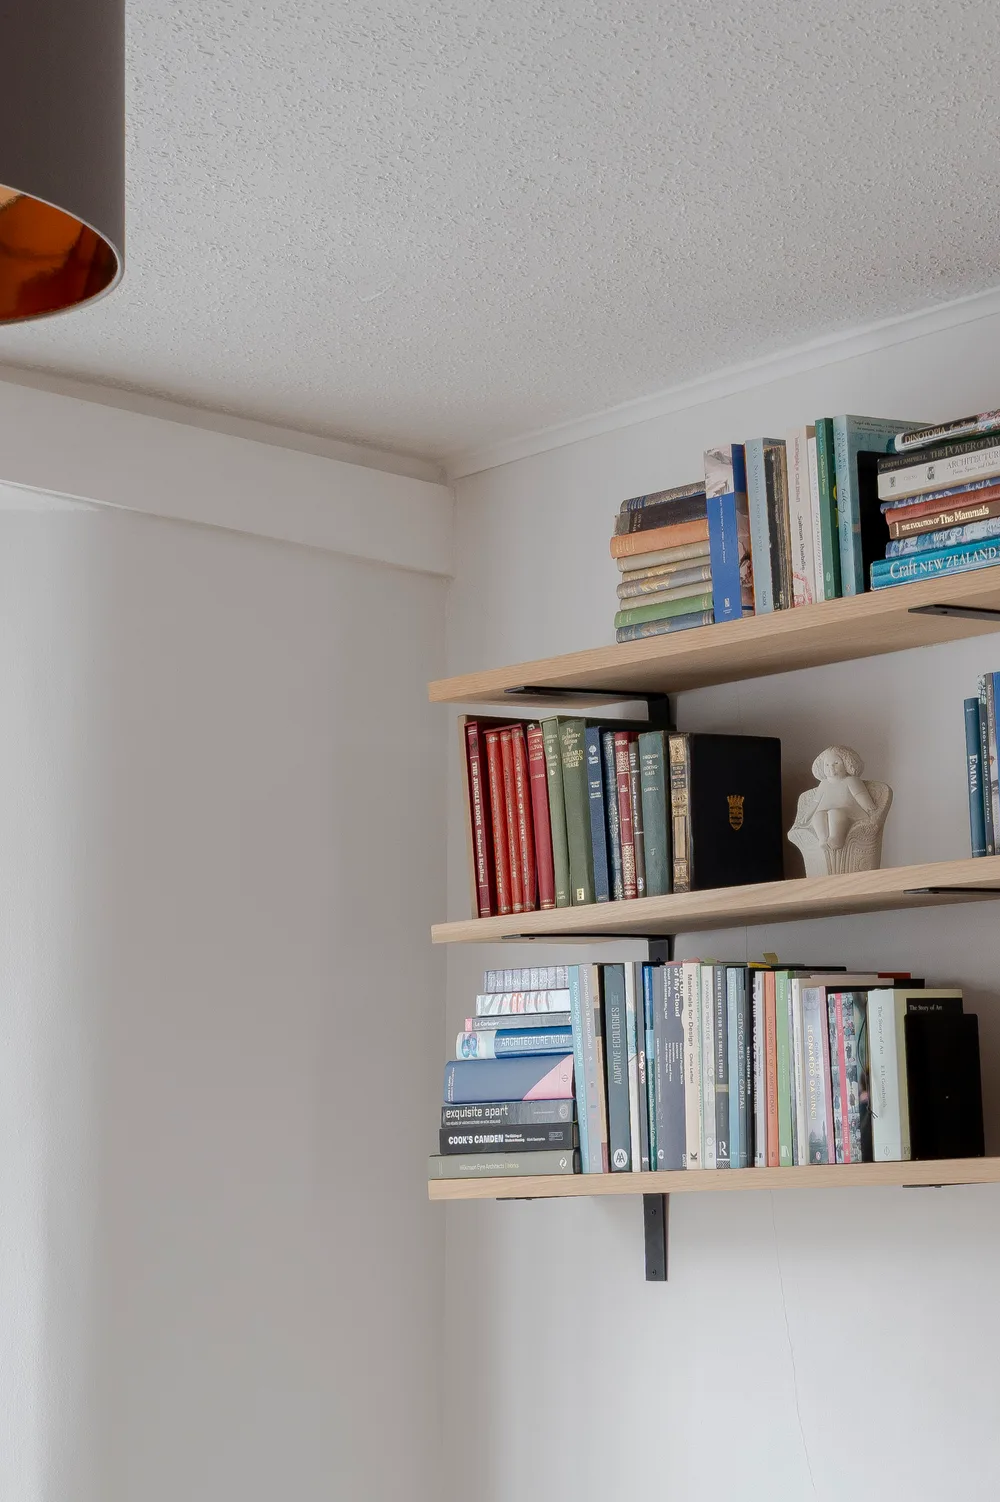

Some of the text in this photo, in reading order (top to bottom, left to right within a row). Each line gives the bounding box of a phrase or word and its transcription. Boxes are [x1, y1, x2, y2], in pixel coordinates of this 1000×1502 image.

[905, 426, 946, 444] DINOTOPIA
[899, 454, 928, 465] CAMPBELL
[944, 442, 976, 457] POWER
[910, 505, 990, 530] EVOLUTION The Mammals
[890, 561, 917, 579] Craft
[919, 557, 945, 573] NEW
[946, 547, 997, 568] ZEALAND
[968, 754, 978, 794] EMMA
[584, 968, 592, 1011] Information
[572, 981, 584, 1067] Knowledge Beautiful
[501, 1036, 548, 1047] ARCHITECTURE
[611, 1007, 622, 1084] ADAPTIVE ECOLOGIES
[806, 1024, 815, 1076] LEONARDO
[446, 1105, 508, 1121] exquisite apart
[448, 1135, 473, 1145] COOK'S
[474, 1134, 504, 1144] CAMDEN
